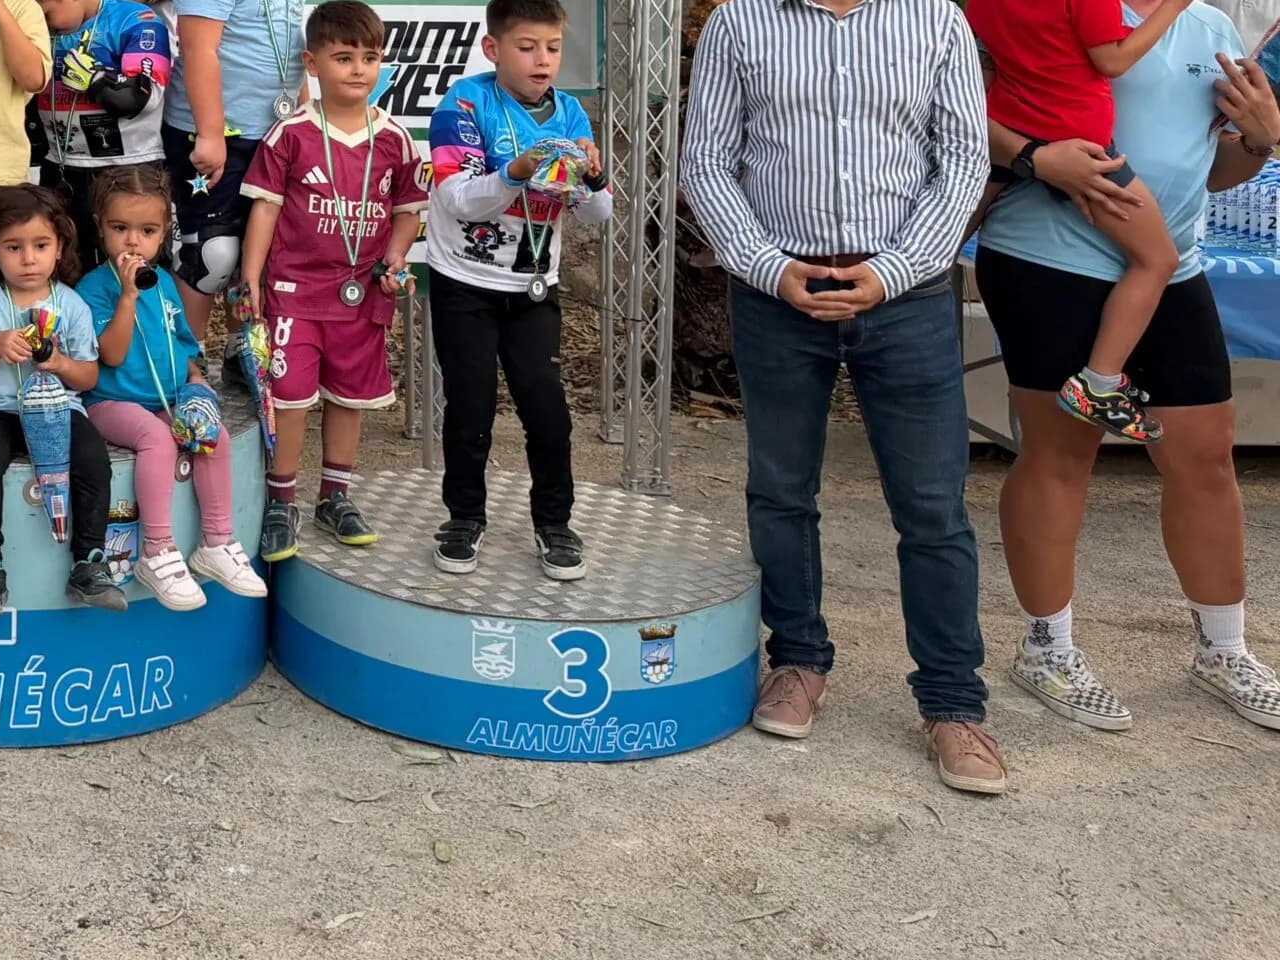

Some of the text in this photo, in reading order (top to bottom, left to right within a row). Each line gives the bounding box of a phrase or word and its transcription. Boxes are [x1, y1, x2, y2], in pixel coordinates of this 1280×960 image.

[381, 20, 481, 64] OUTH
[308, 193, 387, 219] Emirates
[317, 217, 338, 235] FLY
[542, 626, 612, 720] 3
[467, 716, 678, 755] ALMUÑÉCAR
